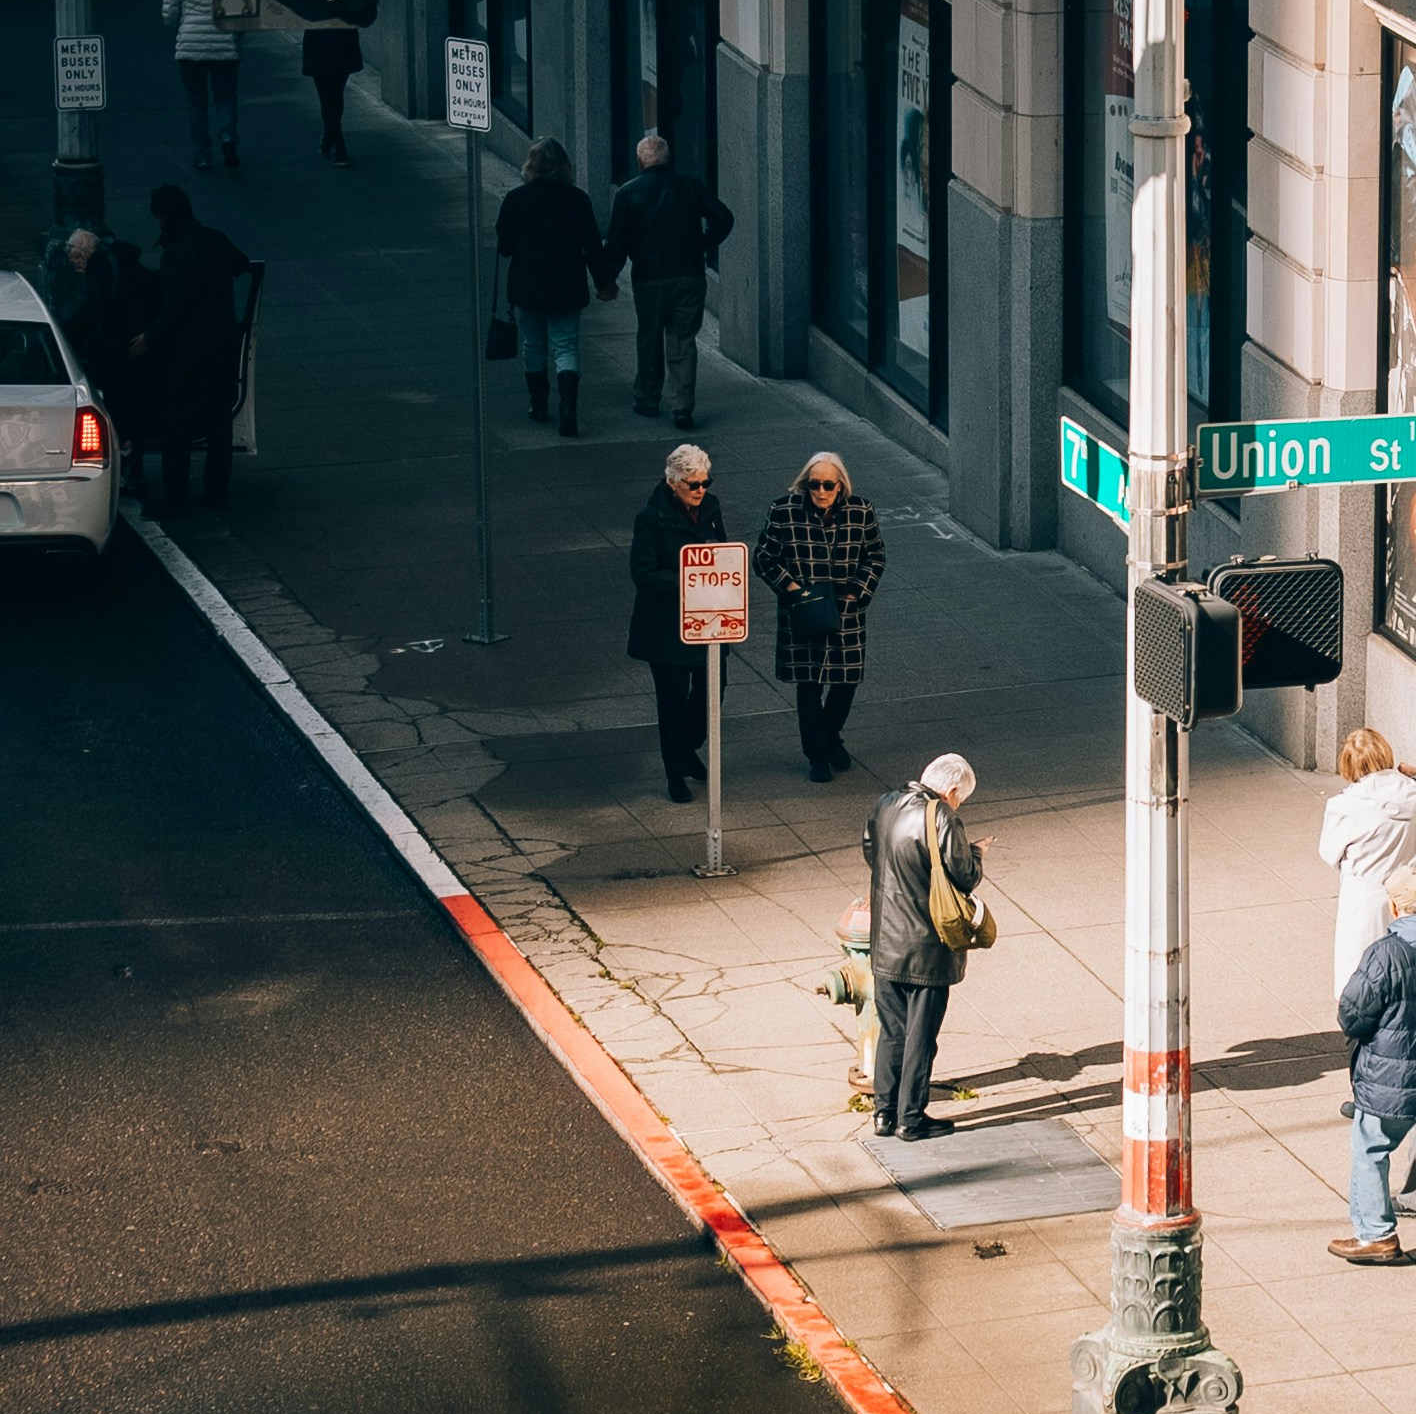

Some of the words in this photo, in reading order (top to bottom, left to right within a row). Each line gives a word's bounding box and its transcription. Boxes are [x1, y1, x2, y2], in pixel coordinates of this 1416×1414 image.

[61, 43, 98, 54] METRO
[452, 48, 484, 62] METRO
[61, 57, 99, 67] BUSES
[902, 45, 920, 73] THE
[65, 69, 95, 79] ONLY
[452, 63, 484, 78] BUSES
[61, 84, 72, 92] 24
[75, 83, 101, 92] HOURS
[455, 79, 481, 93] ONLY
[902, 68, 920, 105] FIVE
[452, 96, 461, 105] 24
[463, 98, 486, 109] HOURS
[453, 110, 485, 120] EVERYDAY
[1212, 430, 1330, 479] Union
[1370, 438, 1401, 472] St
[687, 548, 712, 565] NO
[688, 572, 741, 587] STOPS
